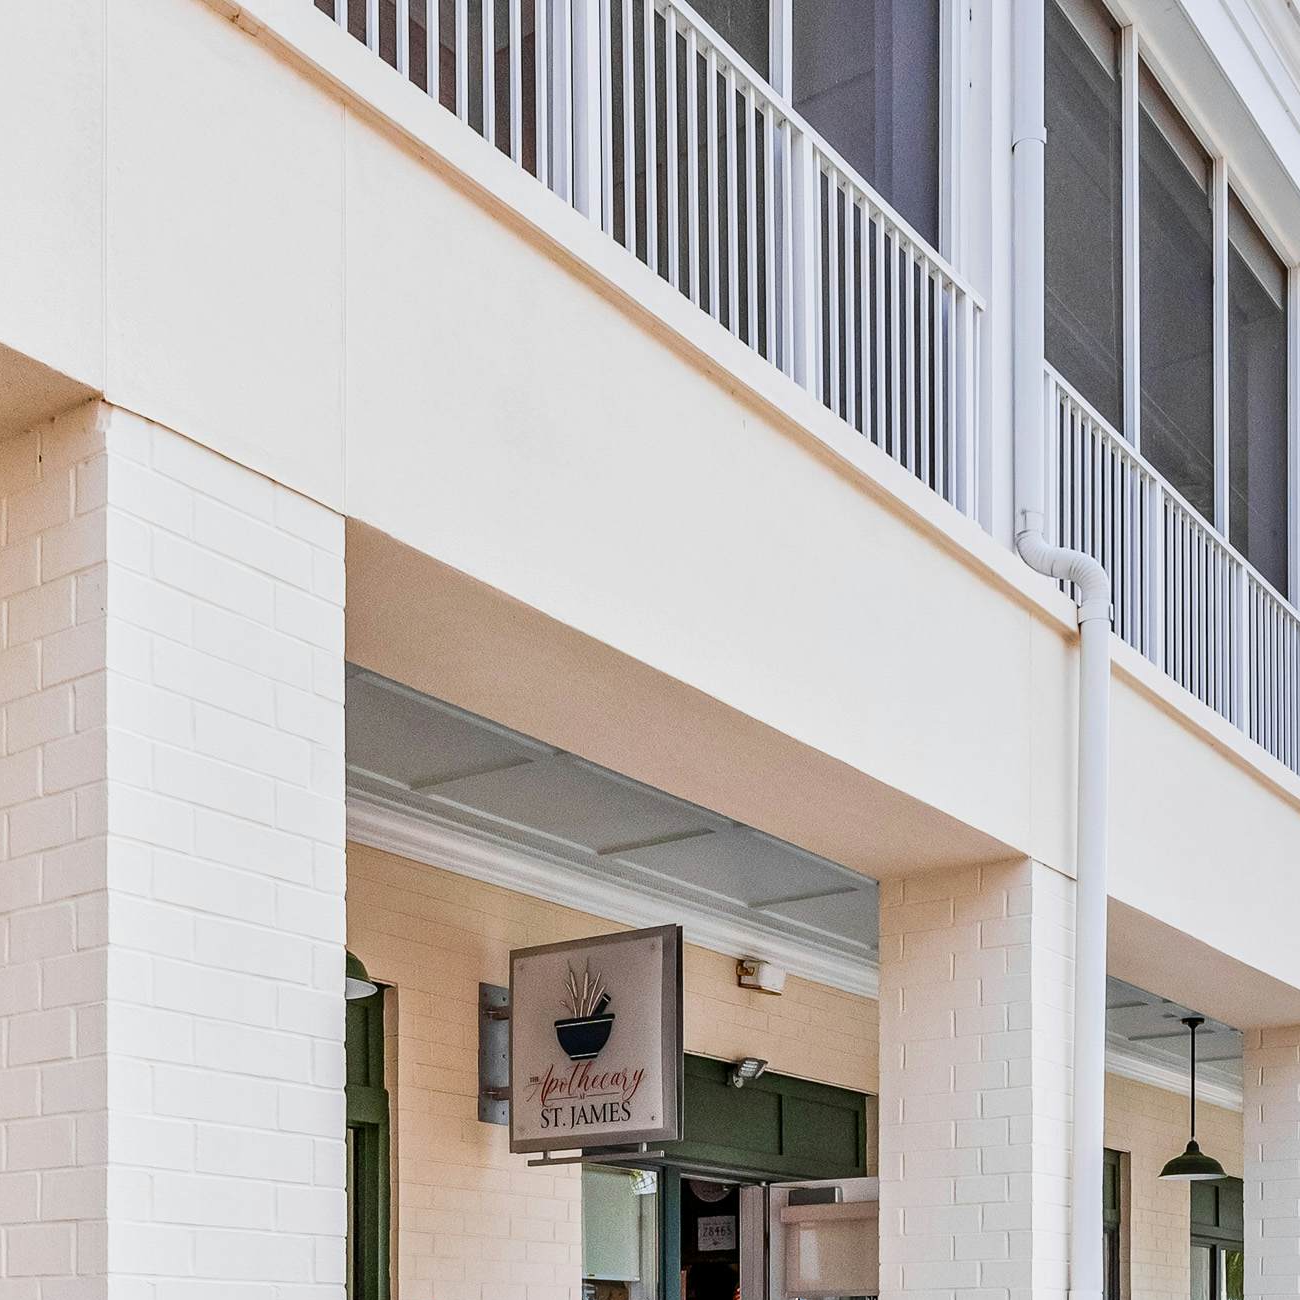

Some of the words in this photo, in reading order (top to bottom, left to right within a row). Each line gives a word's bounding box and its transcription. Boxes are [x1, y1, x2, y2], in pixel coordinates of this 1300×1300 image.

[524, 1061, 644, 1107] Apothecary
[541, 1107, 566, 1129] ST.
[571, 1101, 631, 1129] JAMES
